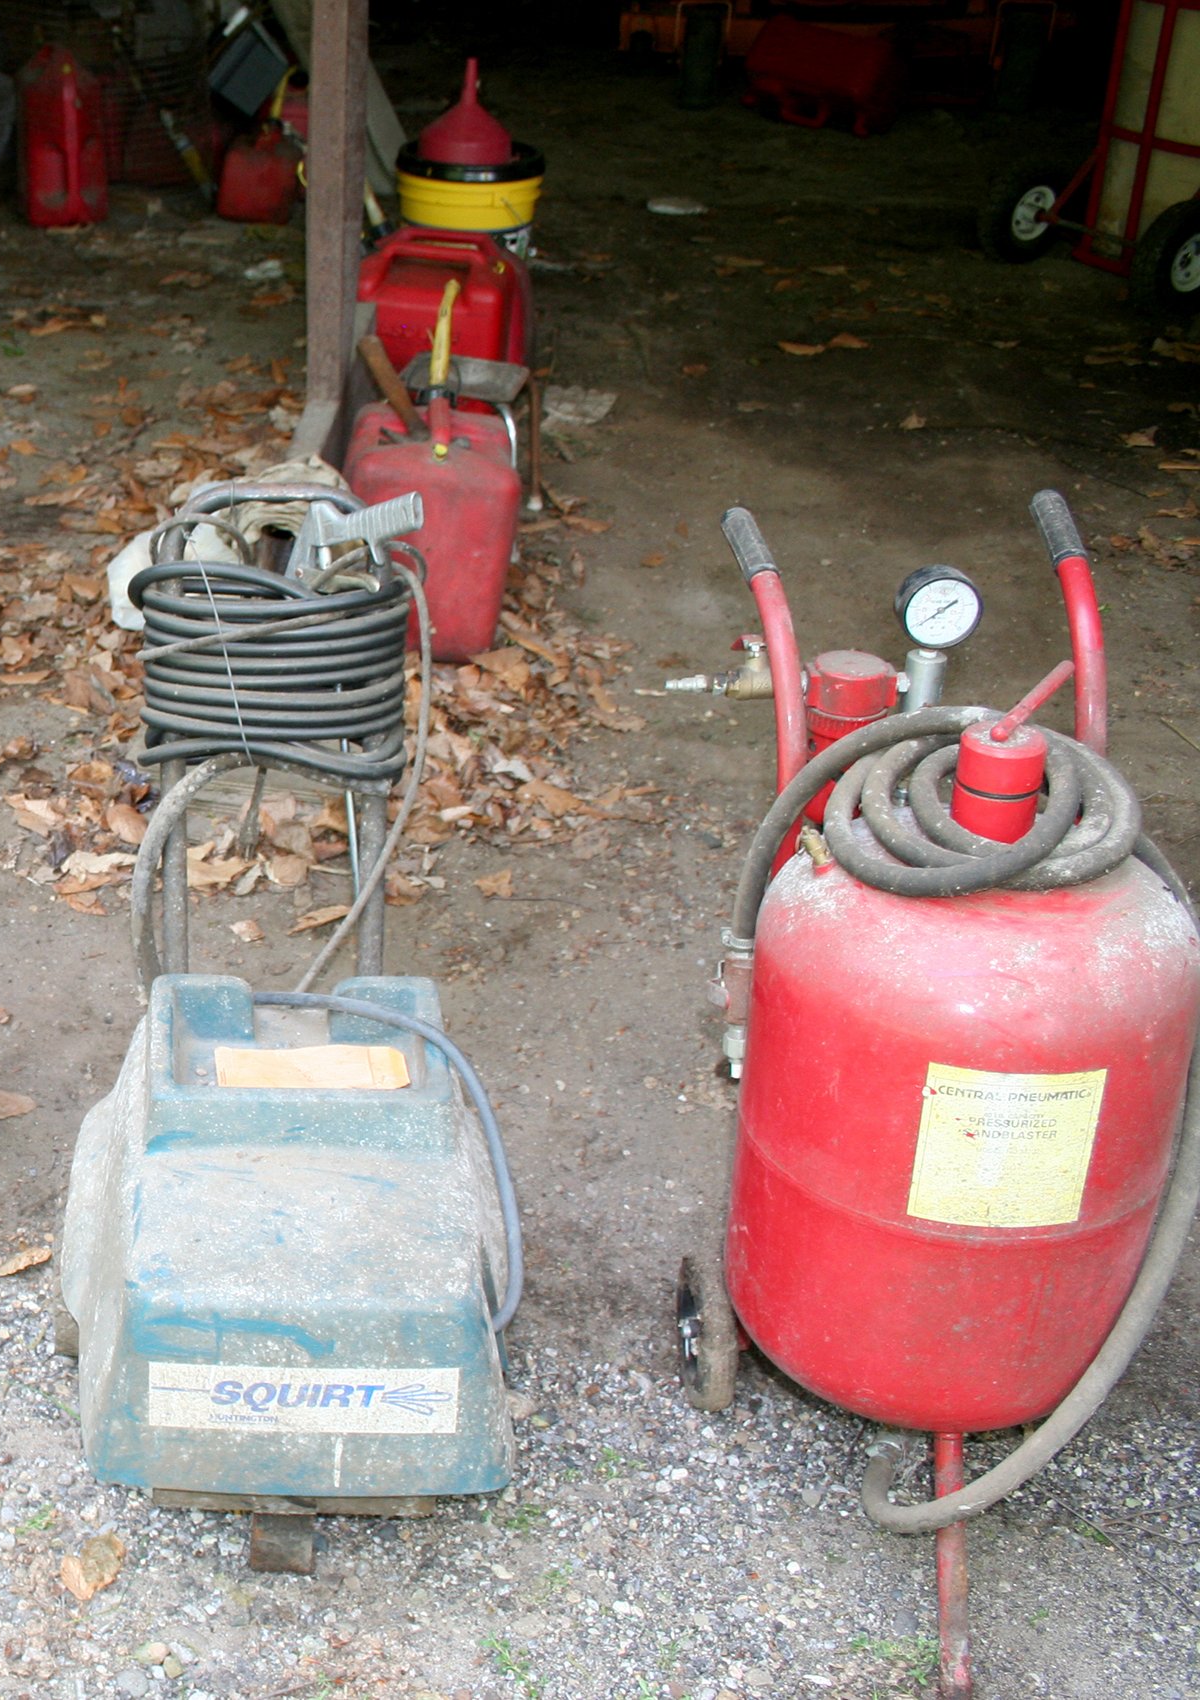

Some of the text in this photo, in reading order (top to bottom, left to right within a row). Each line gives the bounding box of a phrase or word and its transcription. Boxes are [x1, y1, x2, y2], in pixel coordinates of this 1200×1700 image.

[938, 1085, 1088, 1102] CENTRAL PNEUMATIC
[968, 1117, 1057, 1128] PRESSURIZED
[210, 1380, 385, 1412] SQUIRT
